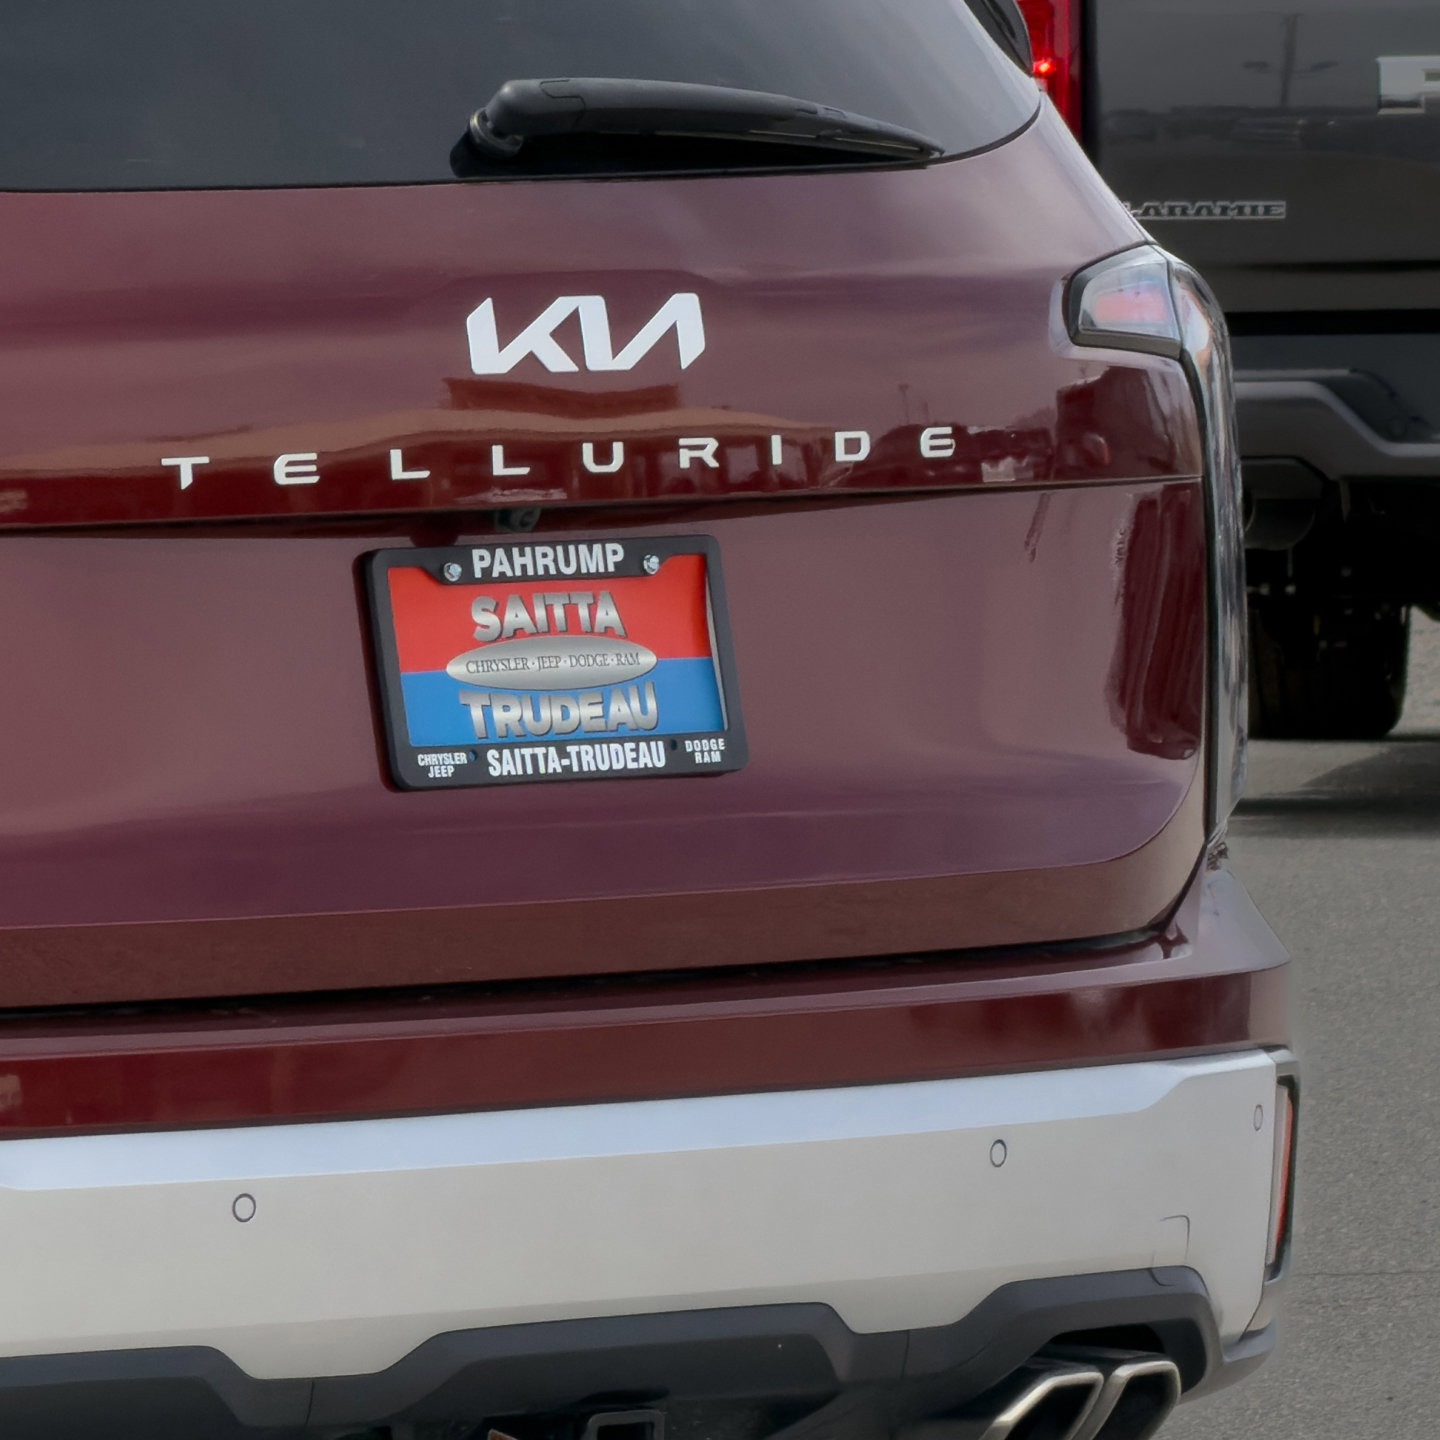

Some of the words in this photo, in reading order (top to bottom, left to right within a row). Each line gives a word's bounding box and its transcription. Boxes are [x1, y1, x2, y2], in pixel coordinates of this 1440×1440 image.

[466, 293, 705, 375] KIA
[161, 427, 956, 491] TELLURIDE
[471, 543, 625, 579] PAHRUMP
[470, 590, 629, 642] SAITTA
[466, 657, 530, 675] CHRYSLER
[536, 656, 562, 672] JEEP
[569, 653, 610, 669] DODGE
[615, 652, 641, 667] RAM
[458, 680, 660, 739] TRUDEAU
[417, 752, 468, 767] CHRYSLER
[487, 740, 667, 778] SAITTA-TRUDEAU
[684, 738, 726, 752] DODGE
[694, 750, 722, 765] RAM
[428, 765, 455, 778] JEEP
